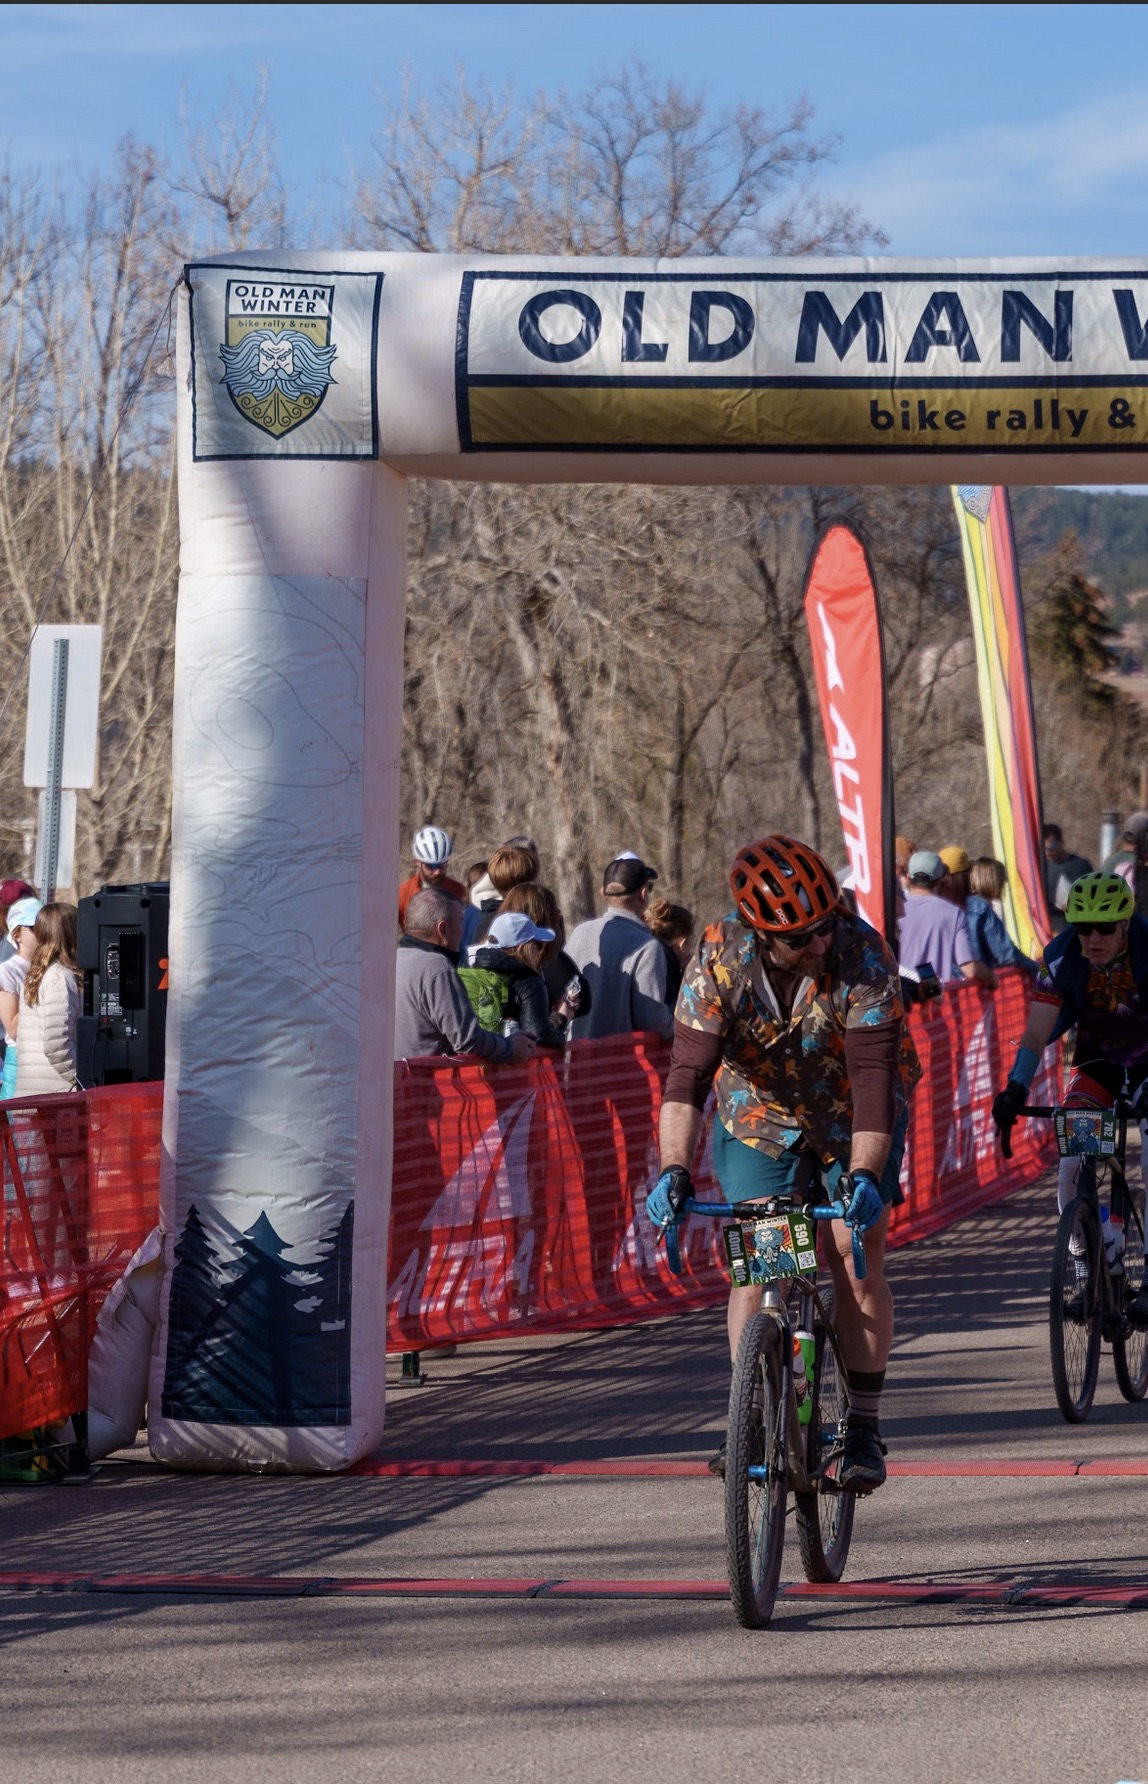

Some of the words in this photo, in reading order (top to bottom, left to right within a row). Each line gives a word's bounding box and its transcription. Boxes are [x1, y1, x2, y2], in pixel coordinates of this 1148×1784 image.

[235, 285, 274, 298] OLD
[280, 288, 326, 300] MAN
[241, 299, 316, 314] WINTER
[238, 319, 260, 328] bike
[263, 320, 286, 330] rally
[289, 320, 296, 328] &
[299, 321, 317, 329] run
[518, 290, 756, 363] OLD
[795, 291, 1074, 363] MAN
[869, 400, 967, 431] bike
[986, 399, 1089, 437] rally
[1107, 398, 1137, 430] &
[1056, 1116, 1066, 1136] 40mi
[1103, 1122, 1114, 1138] 782
[1058, 1136, 1068, 1154] Ride
[727, 1230, 744, 1258] 40mi
[793, 1223, 810, 1247] 590
[386, 1235, 535, 1318] ALTRA
[732, 1258, 747, 1283] Ride
